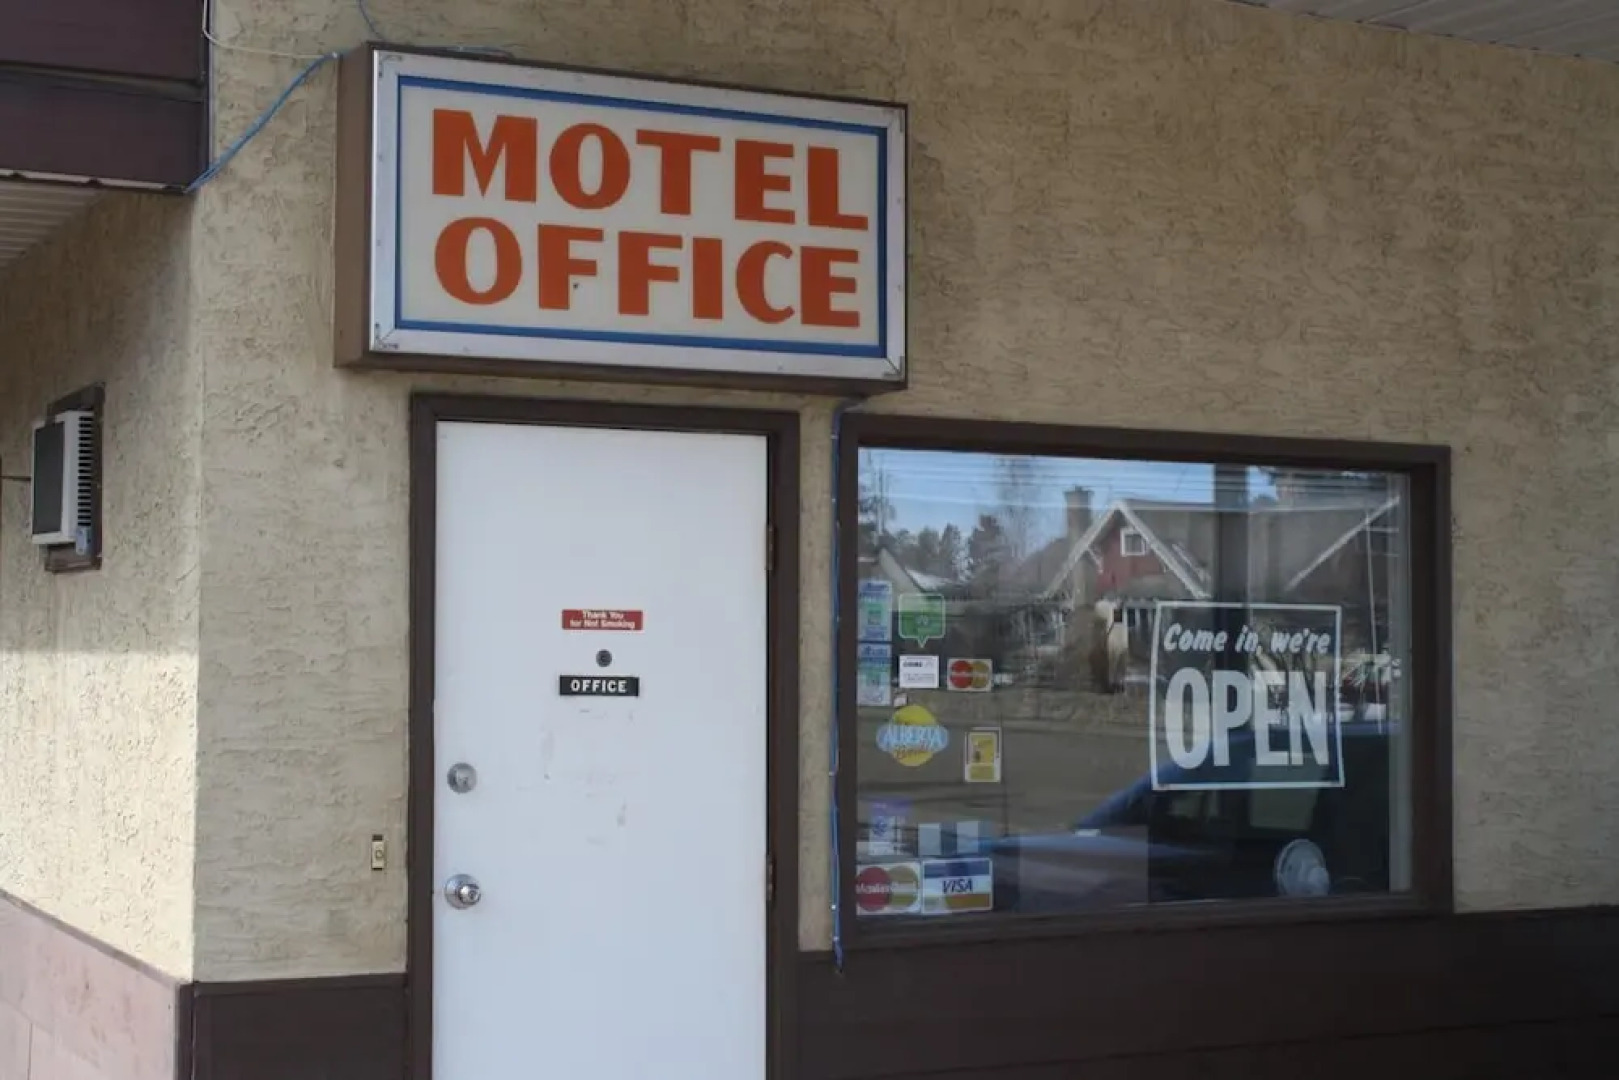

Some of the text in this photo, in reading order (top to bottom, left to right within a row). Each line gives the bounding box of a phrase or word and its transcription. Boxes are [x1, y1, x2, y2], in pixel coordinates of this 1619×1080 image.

[433, 109, 868, 231] MOTEL
[435, 216, 860, 328] OFFICE
[569, 619, 636, 629] for Not Smoking
[582, 610, 624, 620] Thank You
[1163, 622, 1228, 652] Come
[1270, 628, 1332, 654] we're
[570, 679, 628, 694] OFFICE
[1164, 666, 1330, 770] OPEN
[942, 878, 974, 894] VISA
